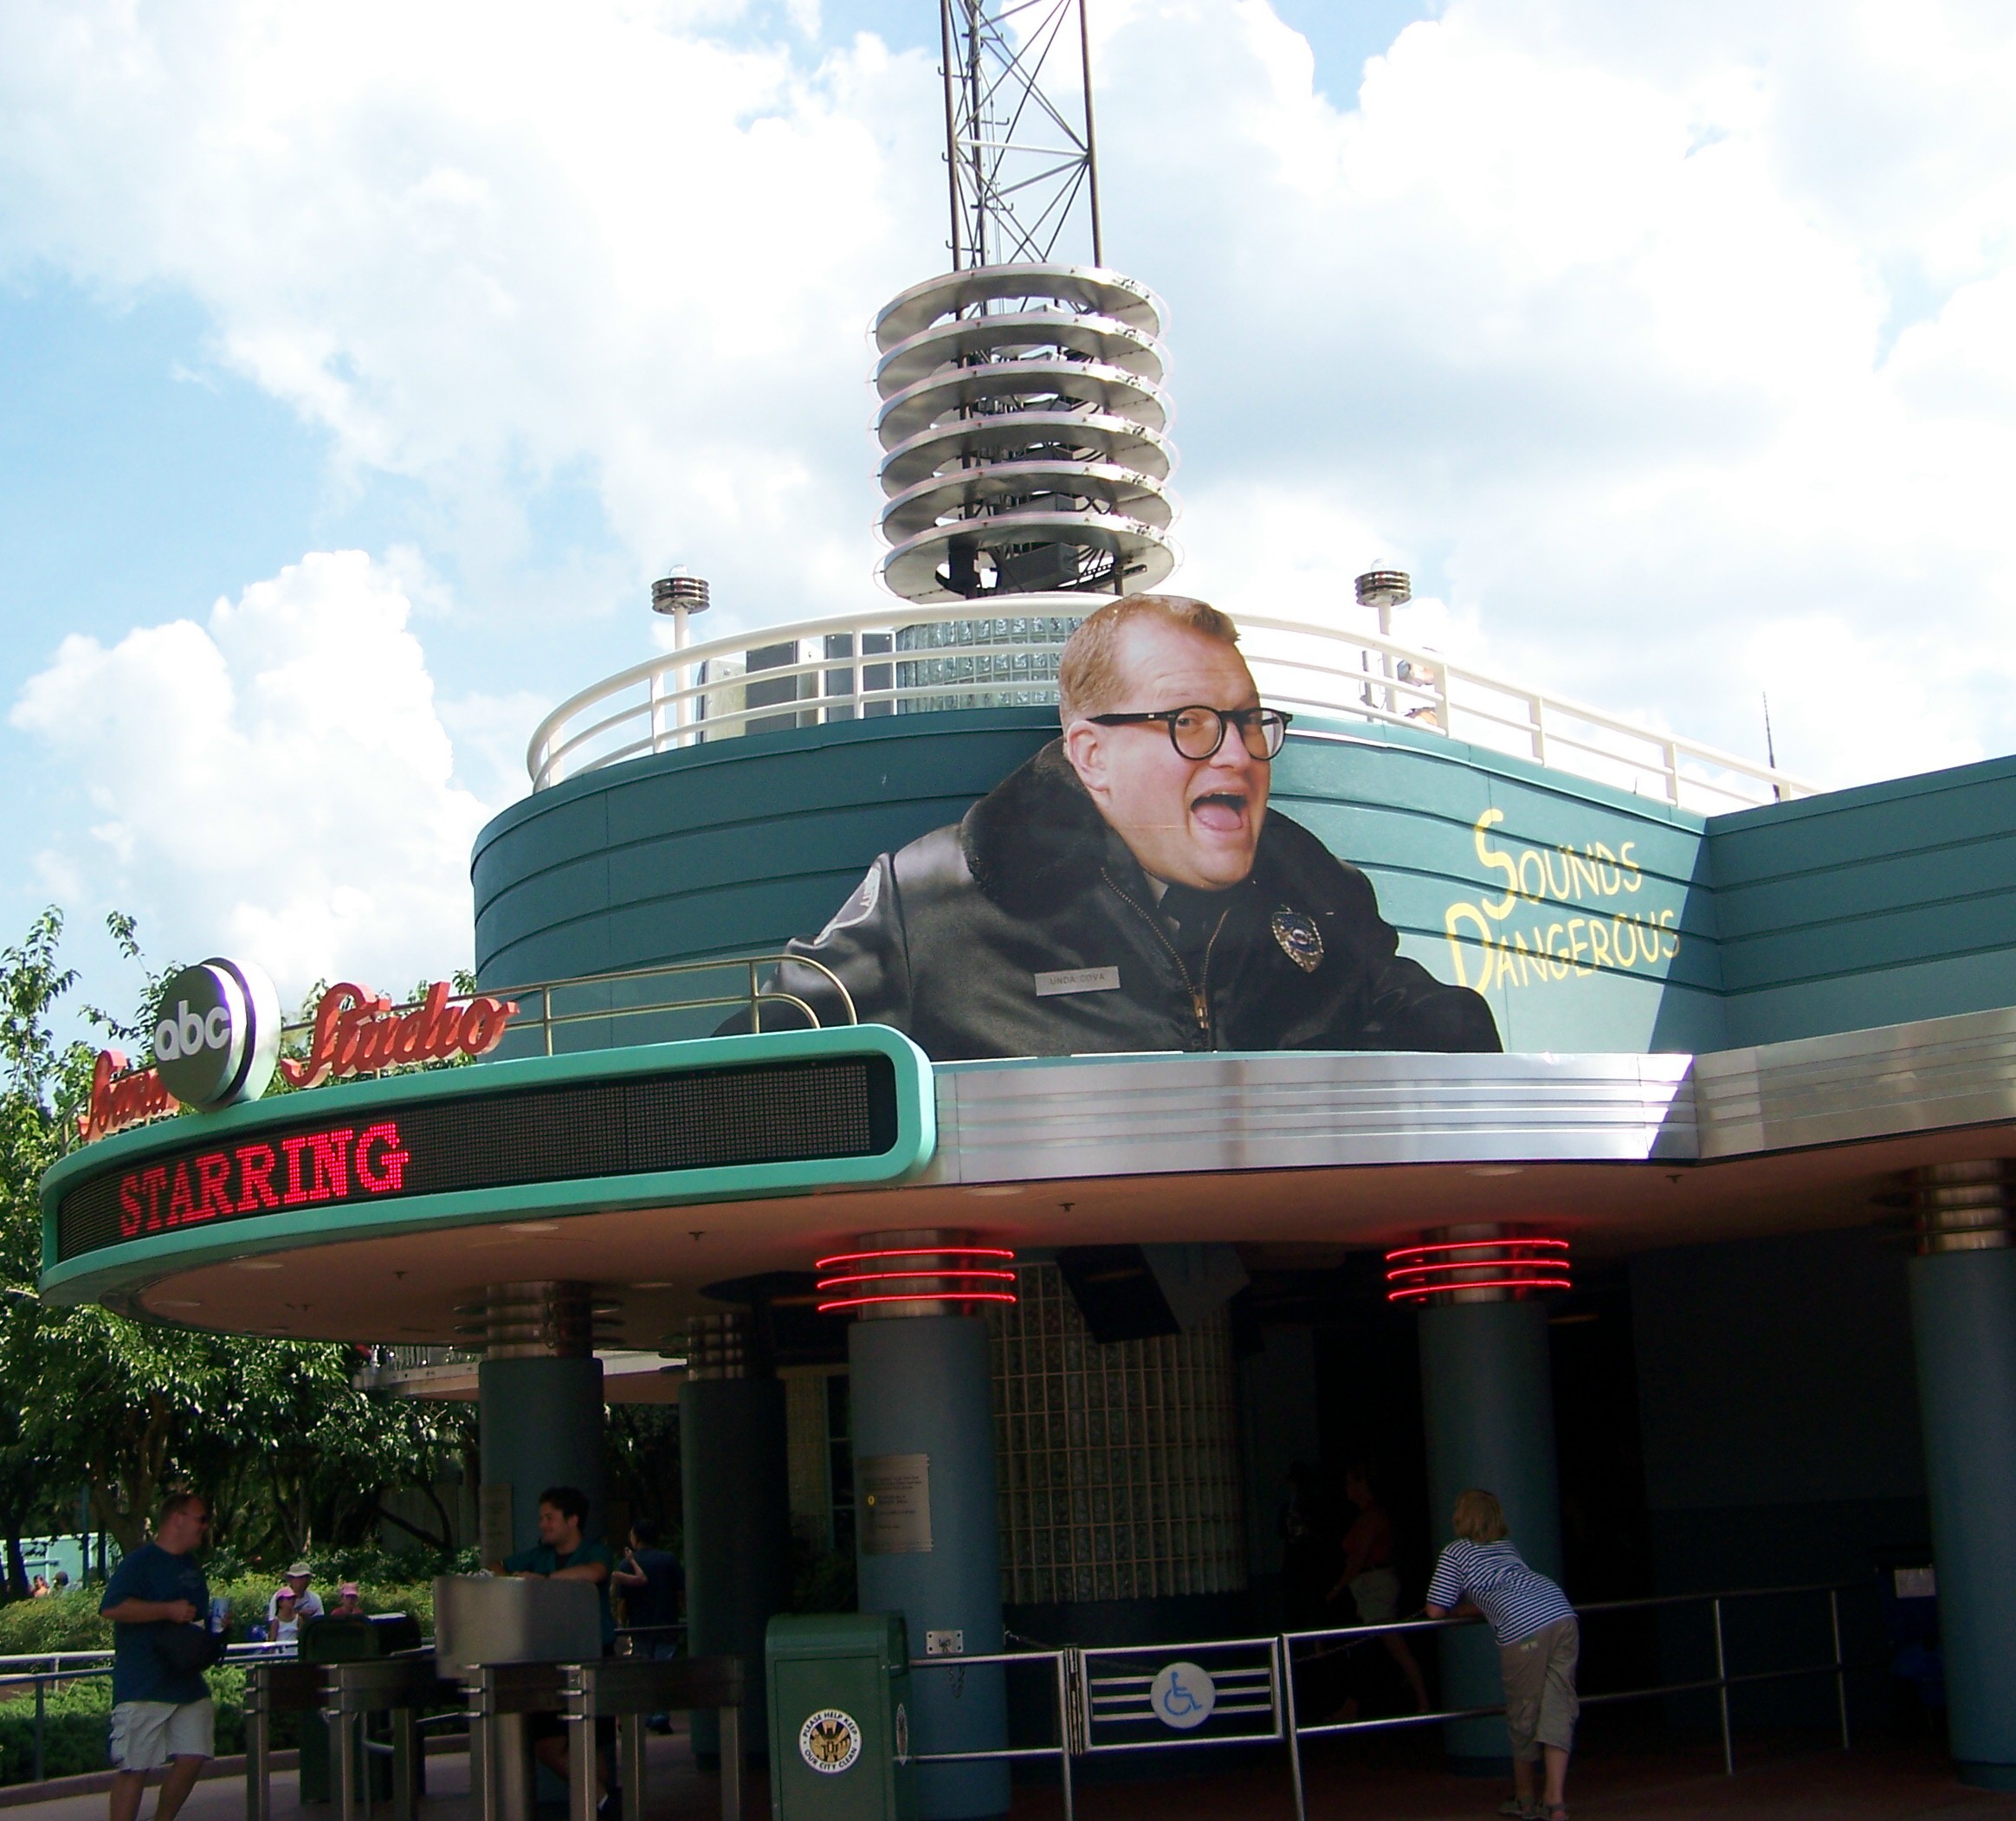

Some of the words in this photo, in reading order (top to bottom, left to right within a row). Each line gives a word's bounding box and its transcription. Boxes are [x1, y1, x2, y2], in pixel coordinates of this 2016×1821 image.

[1476, 809, 1642, 920] SOUNDS
[1445, 902, 1680, 996] DANGEROUS
[154, 999, 232, 1061] abc
[281, 981, 520, 1088] Studio
[120, 1123, 409, 1237] STARRING
[803, 1714, 822, 1737] PLEASE
[843, 1718, 857, 1734] KEEP
[804, 1749, 817, 1765] OUR
[838, 1747, 857, 1767] CLEAN
